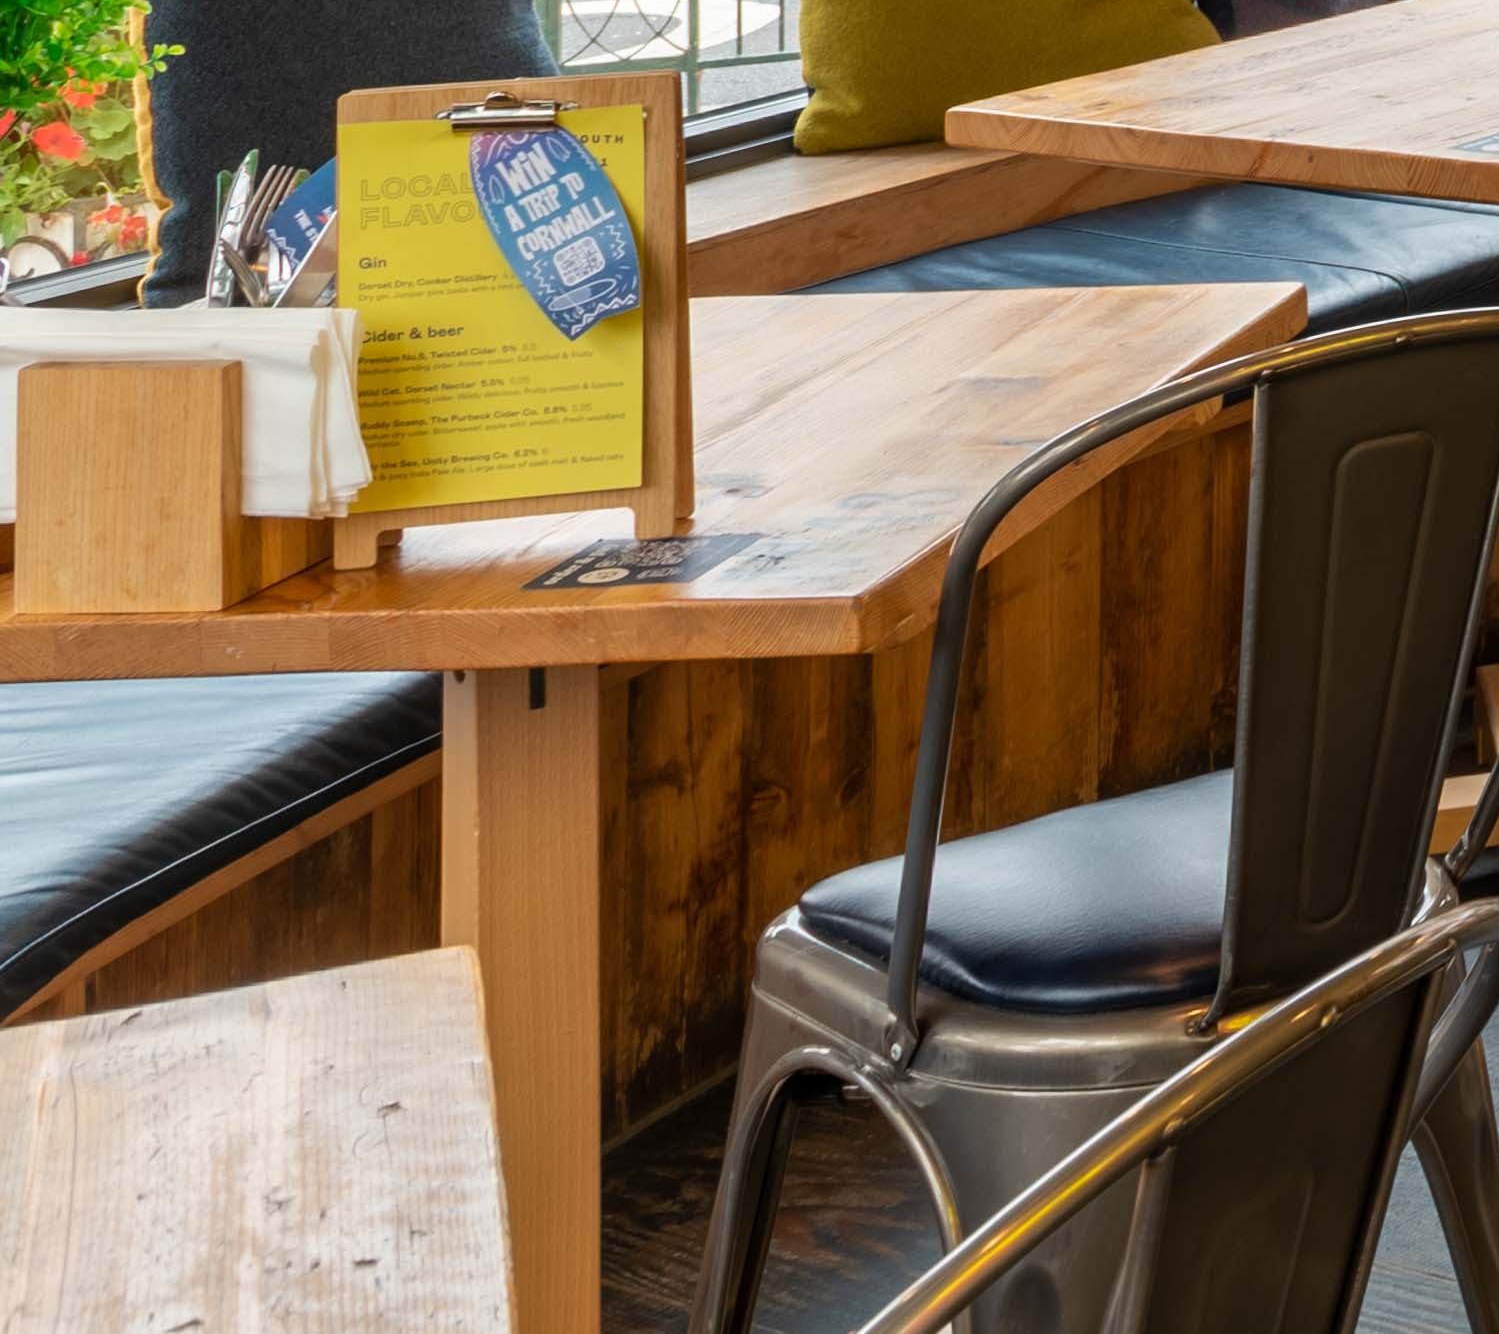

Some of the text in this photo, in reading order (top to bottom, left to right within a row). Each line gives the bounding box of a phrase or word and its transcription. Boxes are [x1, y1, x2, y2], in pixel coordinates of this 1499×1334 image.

[504, 204, 526, 232] A
[559, 172, 585, 200] TO
[516, 196, 617, 261] CORNWALL
[358, 256, 387, 270] Gin
[409, 326, 422, 340] &
[427, 325, 465, 338] beer
